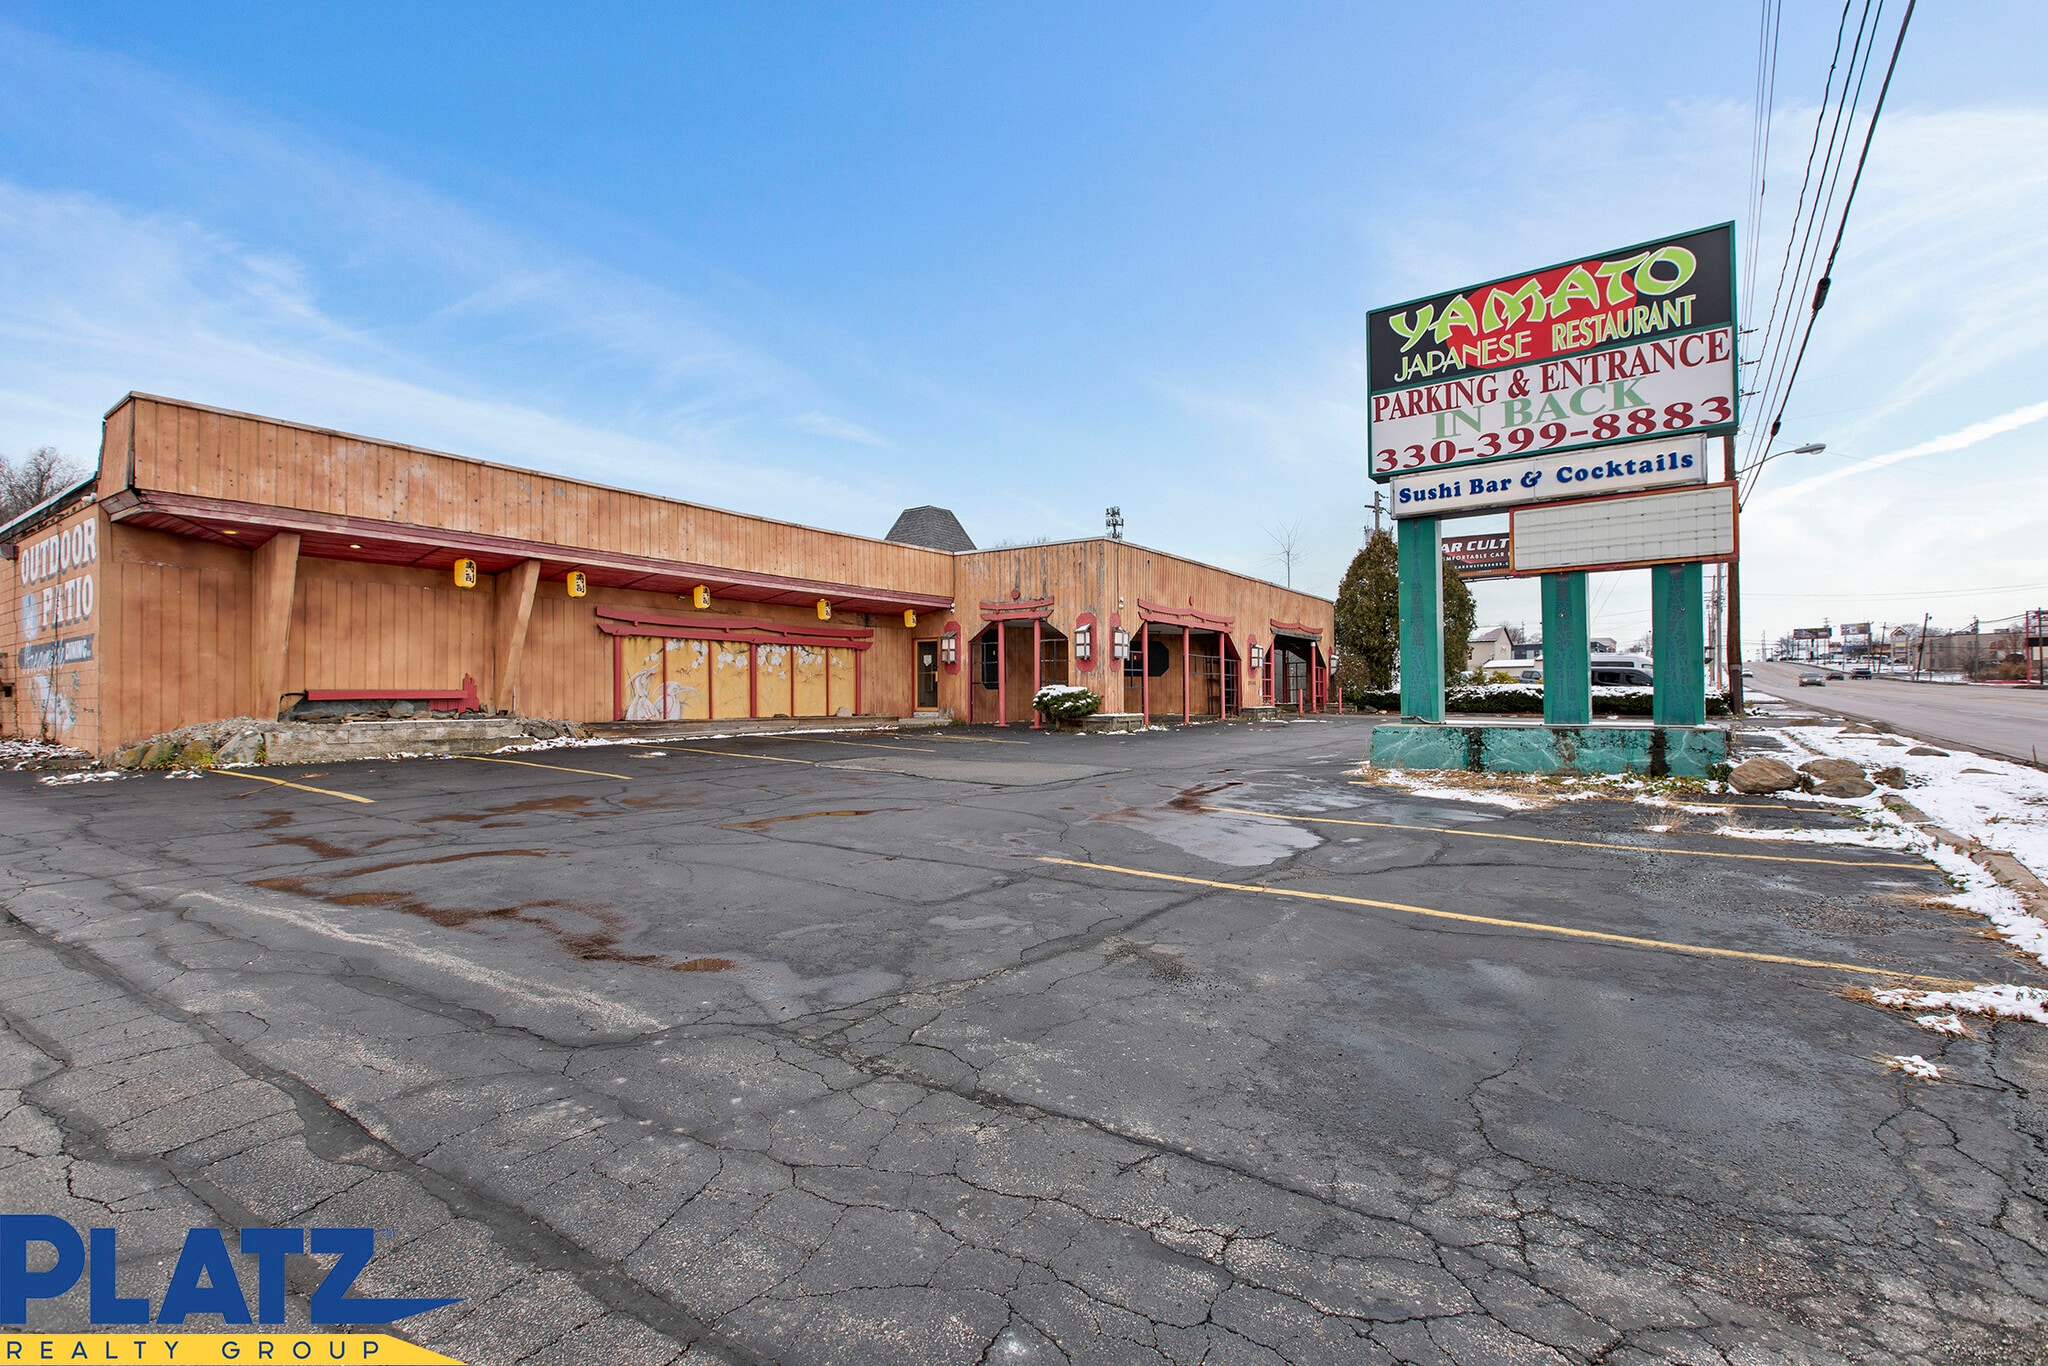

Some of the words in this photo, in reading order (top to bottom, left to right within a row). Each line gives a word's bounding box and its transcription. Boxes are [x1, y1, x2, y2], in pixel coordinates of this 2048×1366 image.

[1389, 246, 1697, 352] YAMATO
[1394, 330, 1532, 382] JAPANESE
[1552, 294, 1696, 352] RESTAURANT
[1373, 374, 1499, 423] PARKING
[1508, 369, 1530, 399] &
[1539, 329, 1730, 393] ENTRANCE
[1432, 405, 1485, 440] IN
[1500, 376, 1650, 429] BACK
[1376, 396, 1732, 473] 330-399-8883
[1399, 481, 1461, 503] Sushi
[1469, 478, 1512, 495] Bar
[1520, 471, 1542, 487] &
[1556, 452, 1693, 483] Cocktails
[21, 517, 97, 587] OUTDOOR
[1442, 542, 1463, 553] AR
[1466, 538, 1509, 551] CULT
[41, 574, 94, 629] PATIO
